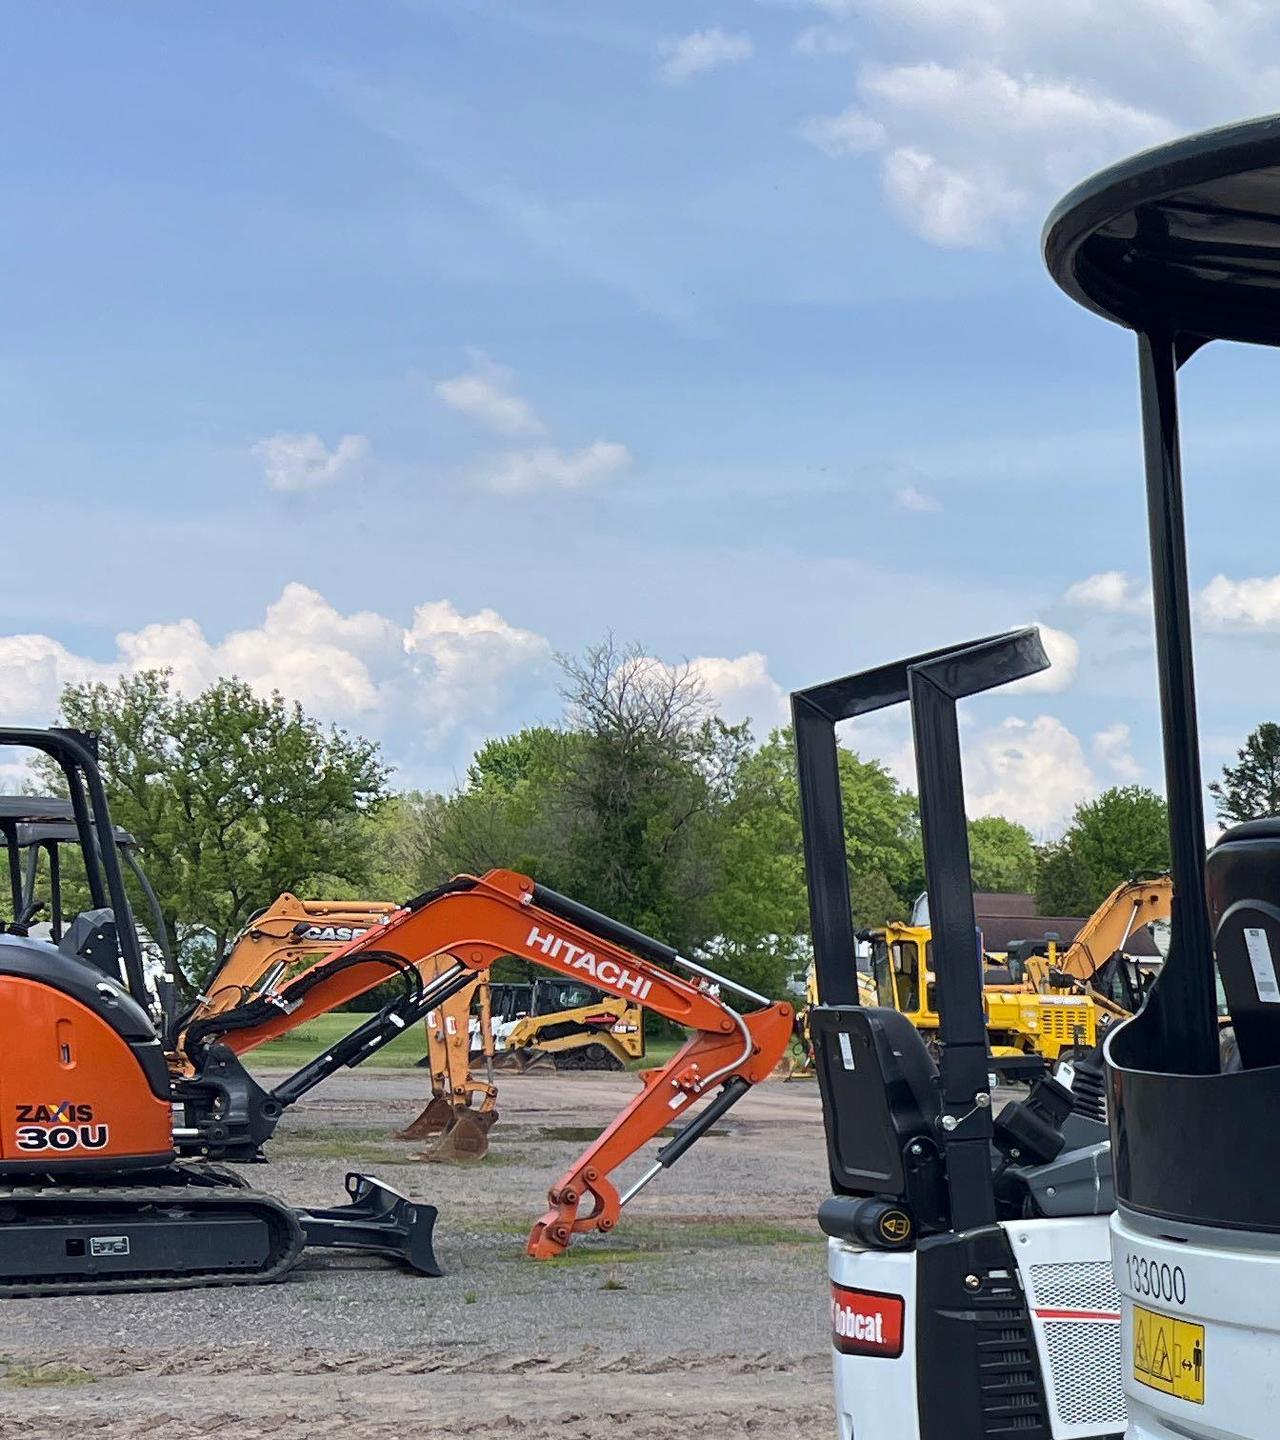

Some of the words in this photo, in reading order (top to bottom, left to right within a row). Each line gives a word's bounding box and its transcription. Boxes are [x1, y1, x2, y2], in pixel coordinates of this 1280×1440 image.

[526, 926, 653, 1000] HITACHI
[16, 1101, 94, 1123] ZAXIS
[16, 1124, 108, 1152] 30U
[1126, 1253, 1186, 1305] 133000
